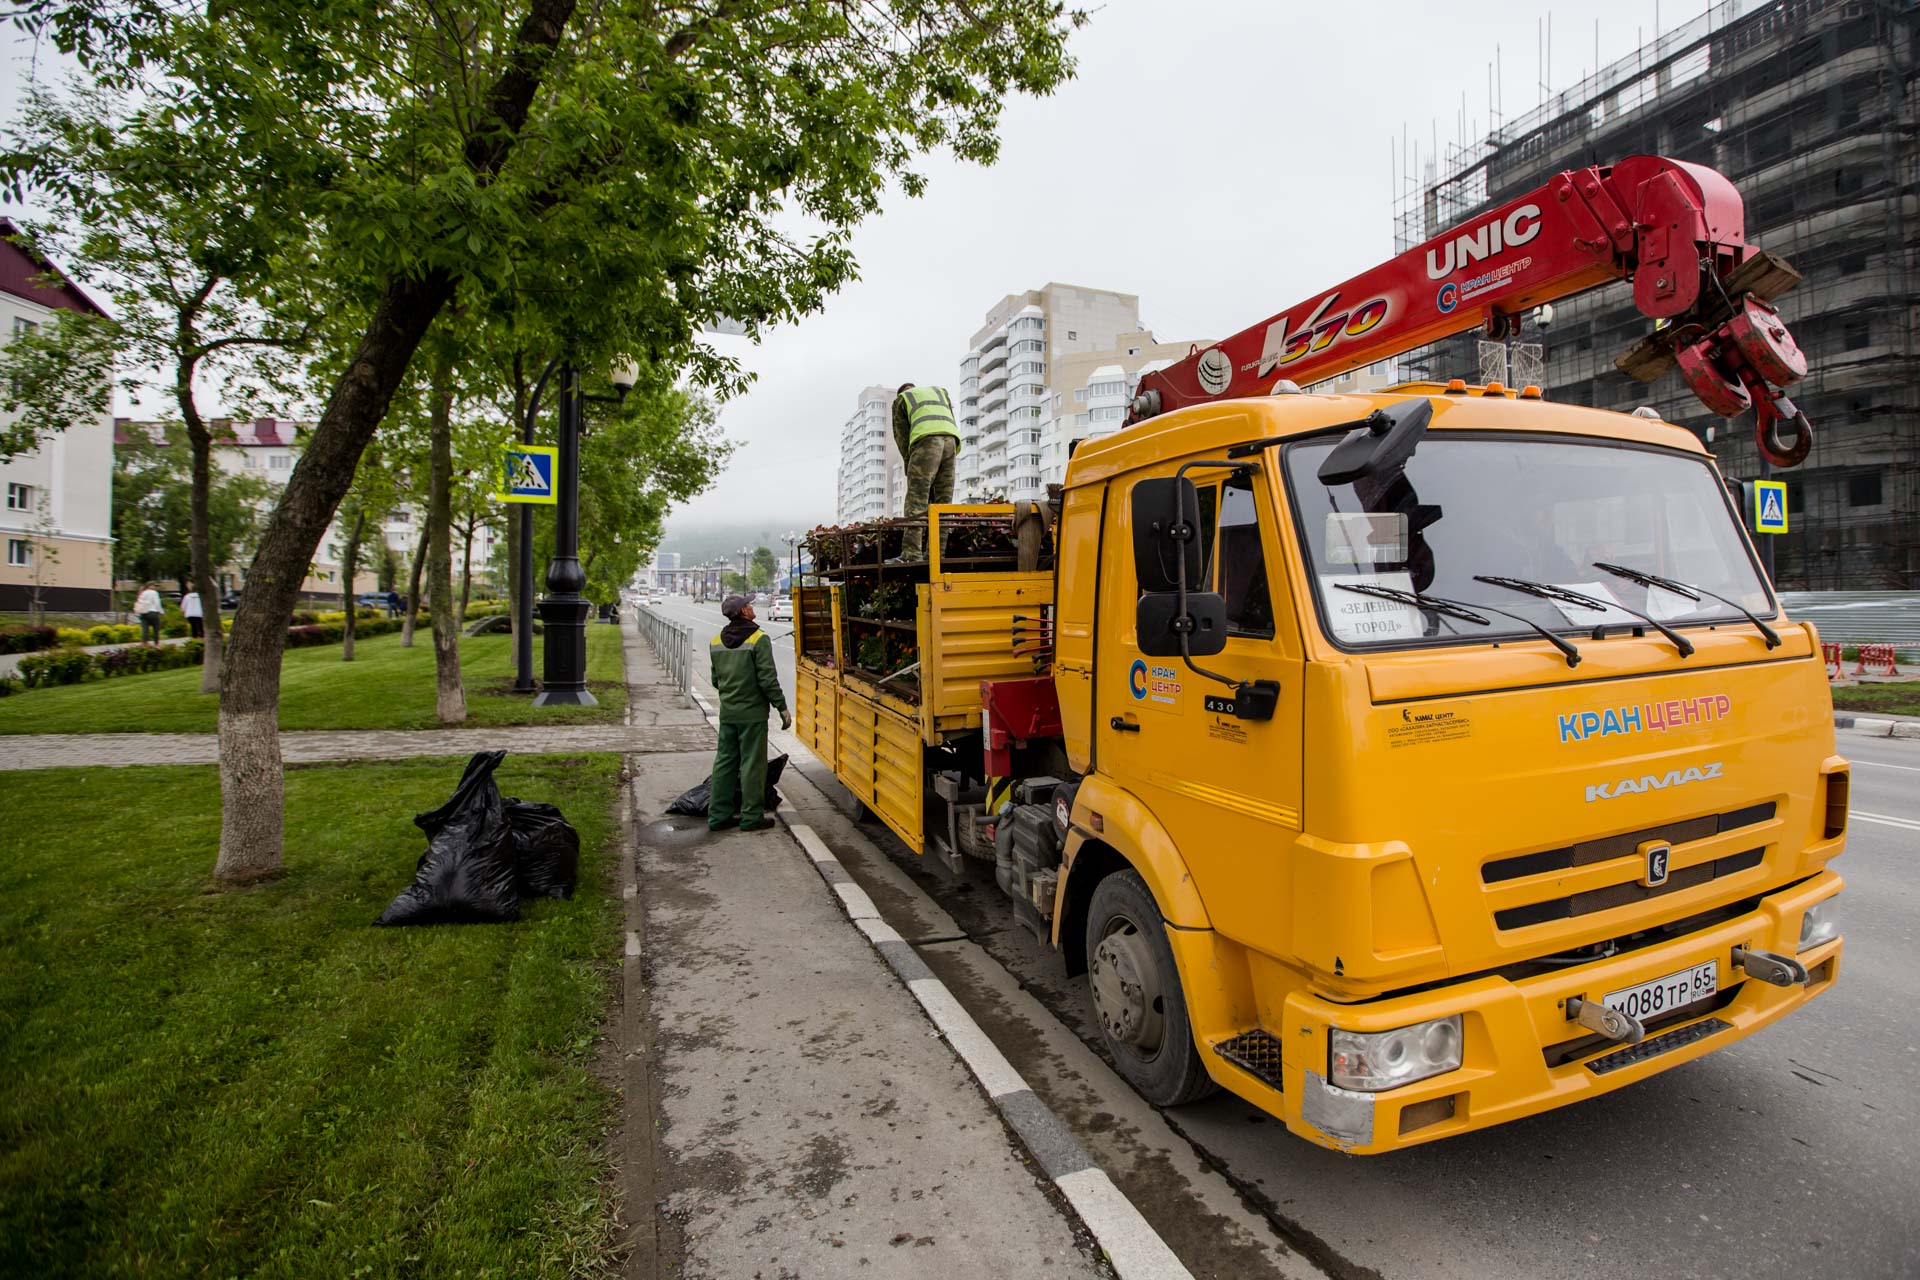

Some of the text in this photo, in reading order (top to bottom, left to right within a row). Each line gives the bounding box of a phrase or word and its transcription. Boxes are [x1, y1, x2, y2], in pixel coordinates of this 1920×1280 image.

[1426, 204, 1542, 280] UNIC
[1460, 272, 1491, 293] КРАН
[1491, 256, 1532, 282] ЦЕНТР
[1355, 620, 1402, 634] ГОРОД»
[1151, 666, 1176, 680] КРАН
[1151, 680, 1182, 695] ЦЕНТР
[1207, 700, 1234, 713] 430
[1558, 694, 1731, 743] КРАН ЦЕНТР
[1585, 762, 1723, 802] KAMAZ
[1693, 966, 1711, 990] 65
[1692, 989, 1706, 999] RUS
